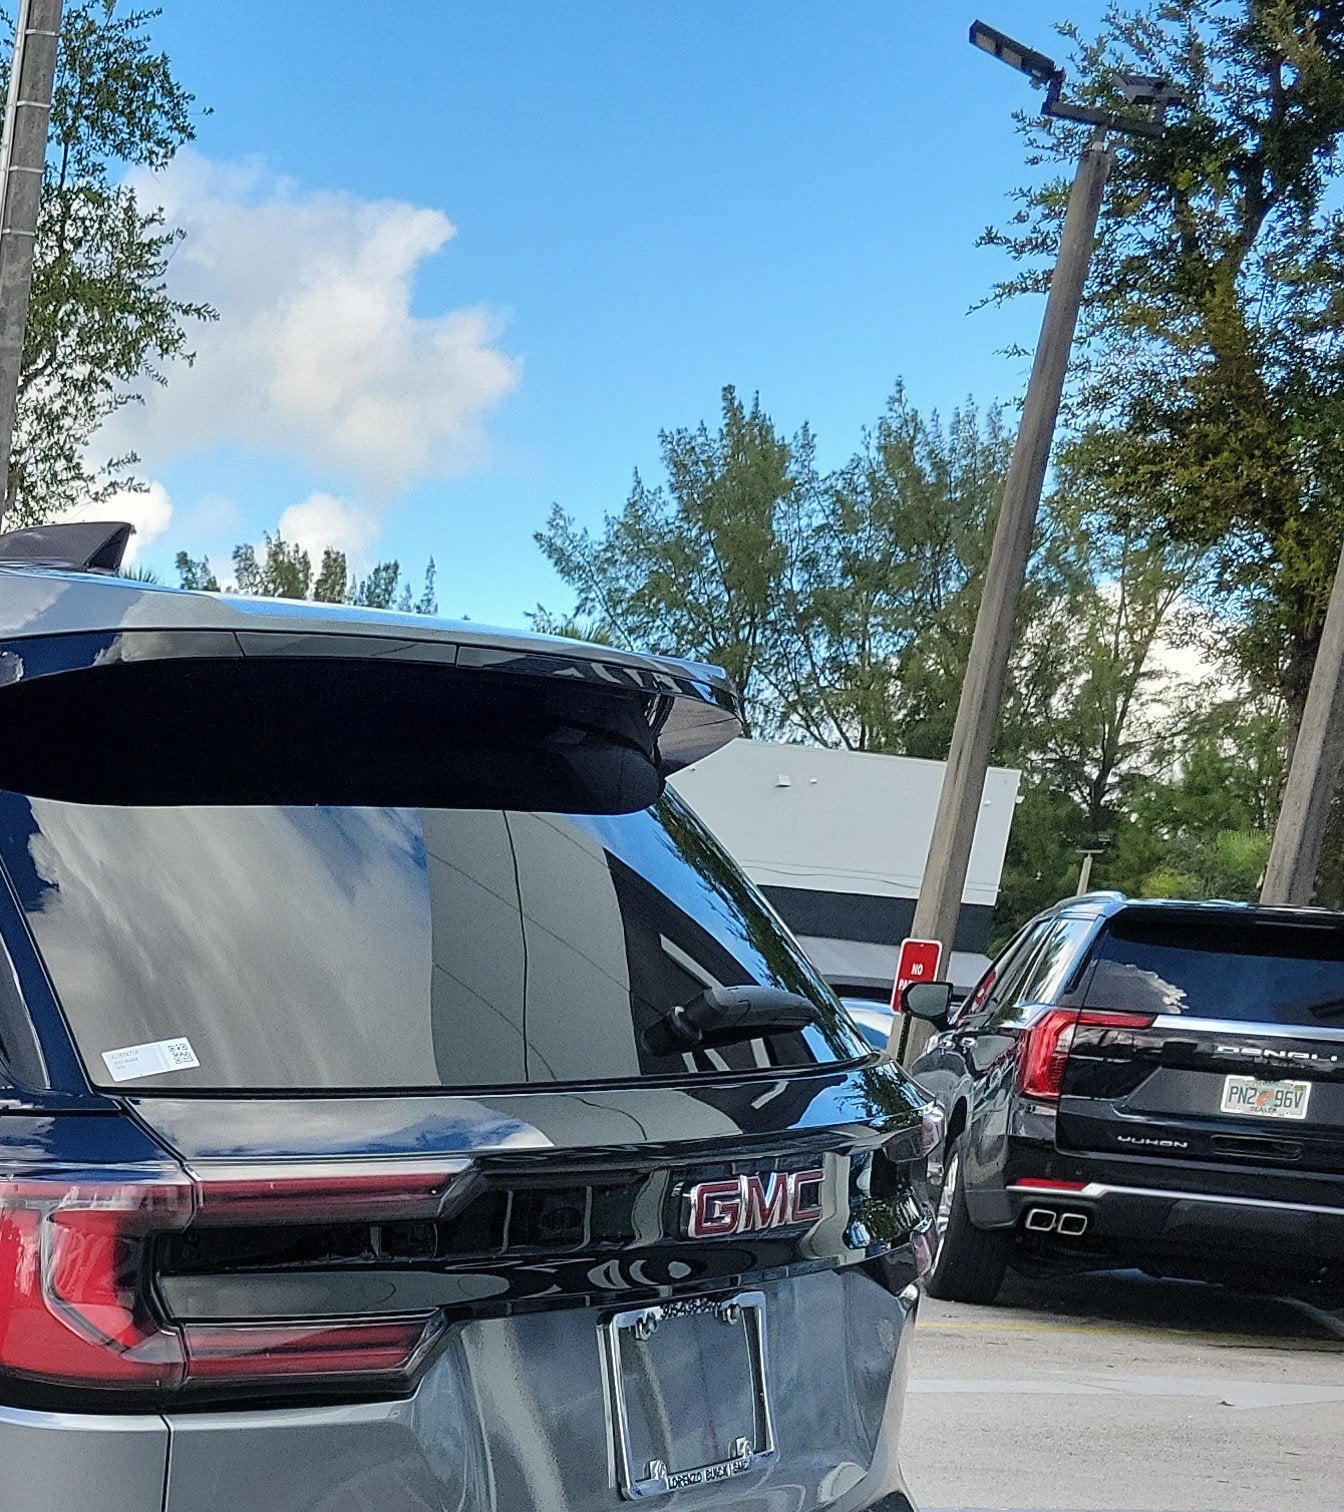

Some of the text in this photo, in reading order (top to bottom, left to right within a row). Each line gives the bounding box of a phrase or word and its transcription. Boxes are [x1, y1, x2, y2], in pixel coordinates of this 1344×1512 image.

[911, 962, 924, 976] NO
[1217, 1046, 1338, 1061] DENALI
[1117, 1135, 1189, 1148] YUKON
[688, 1167, 826, 1239] GMC
